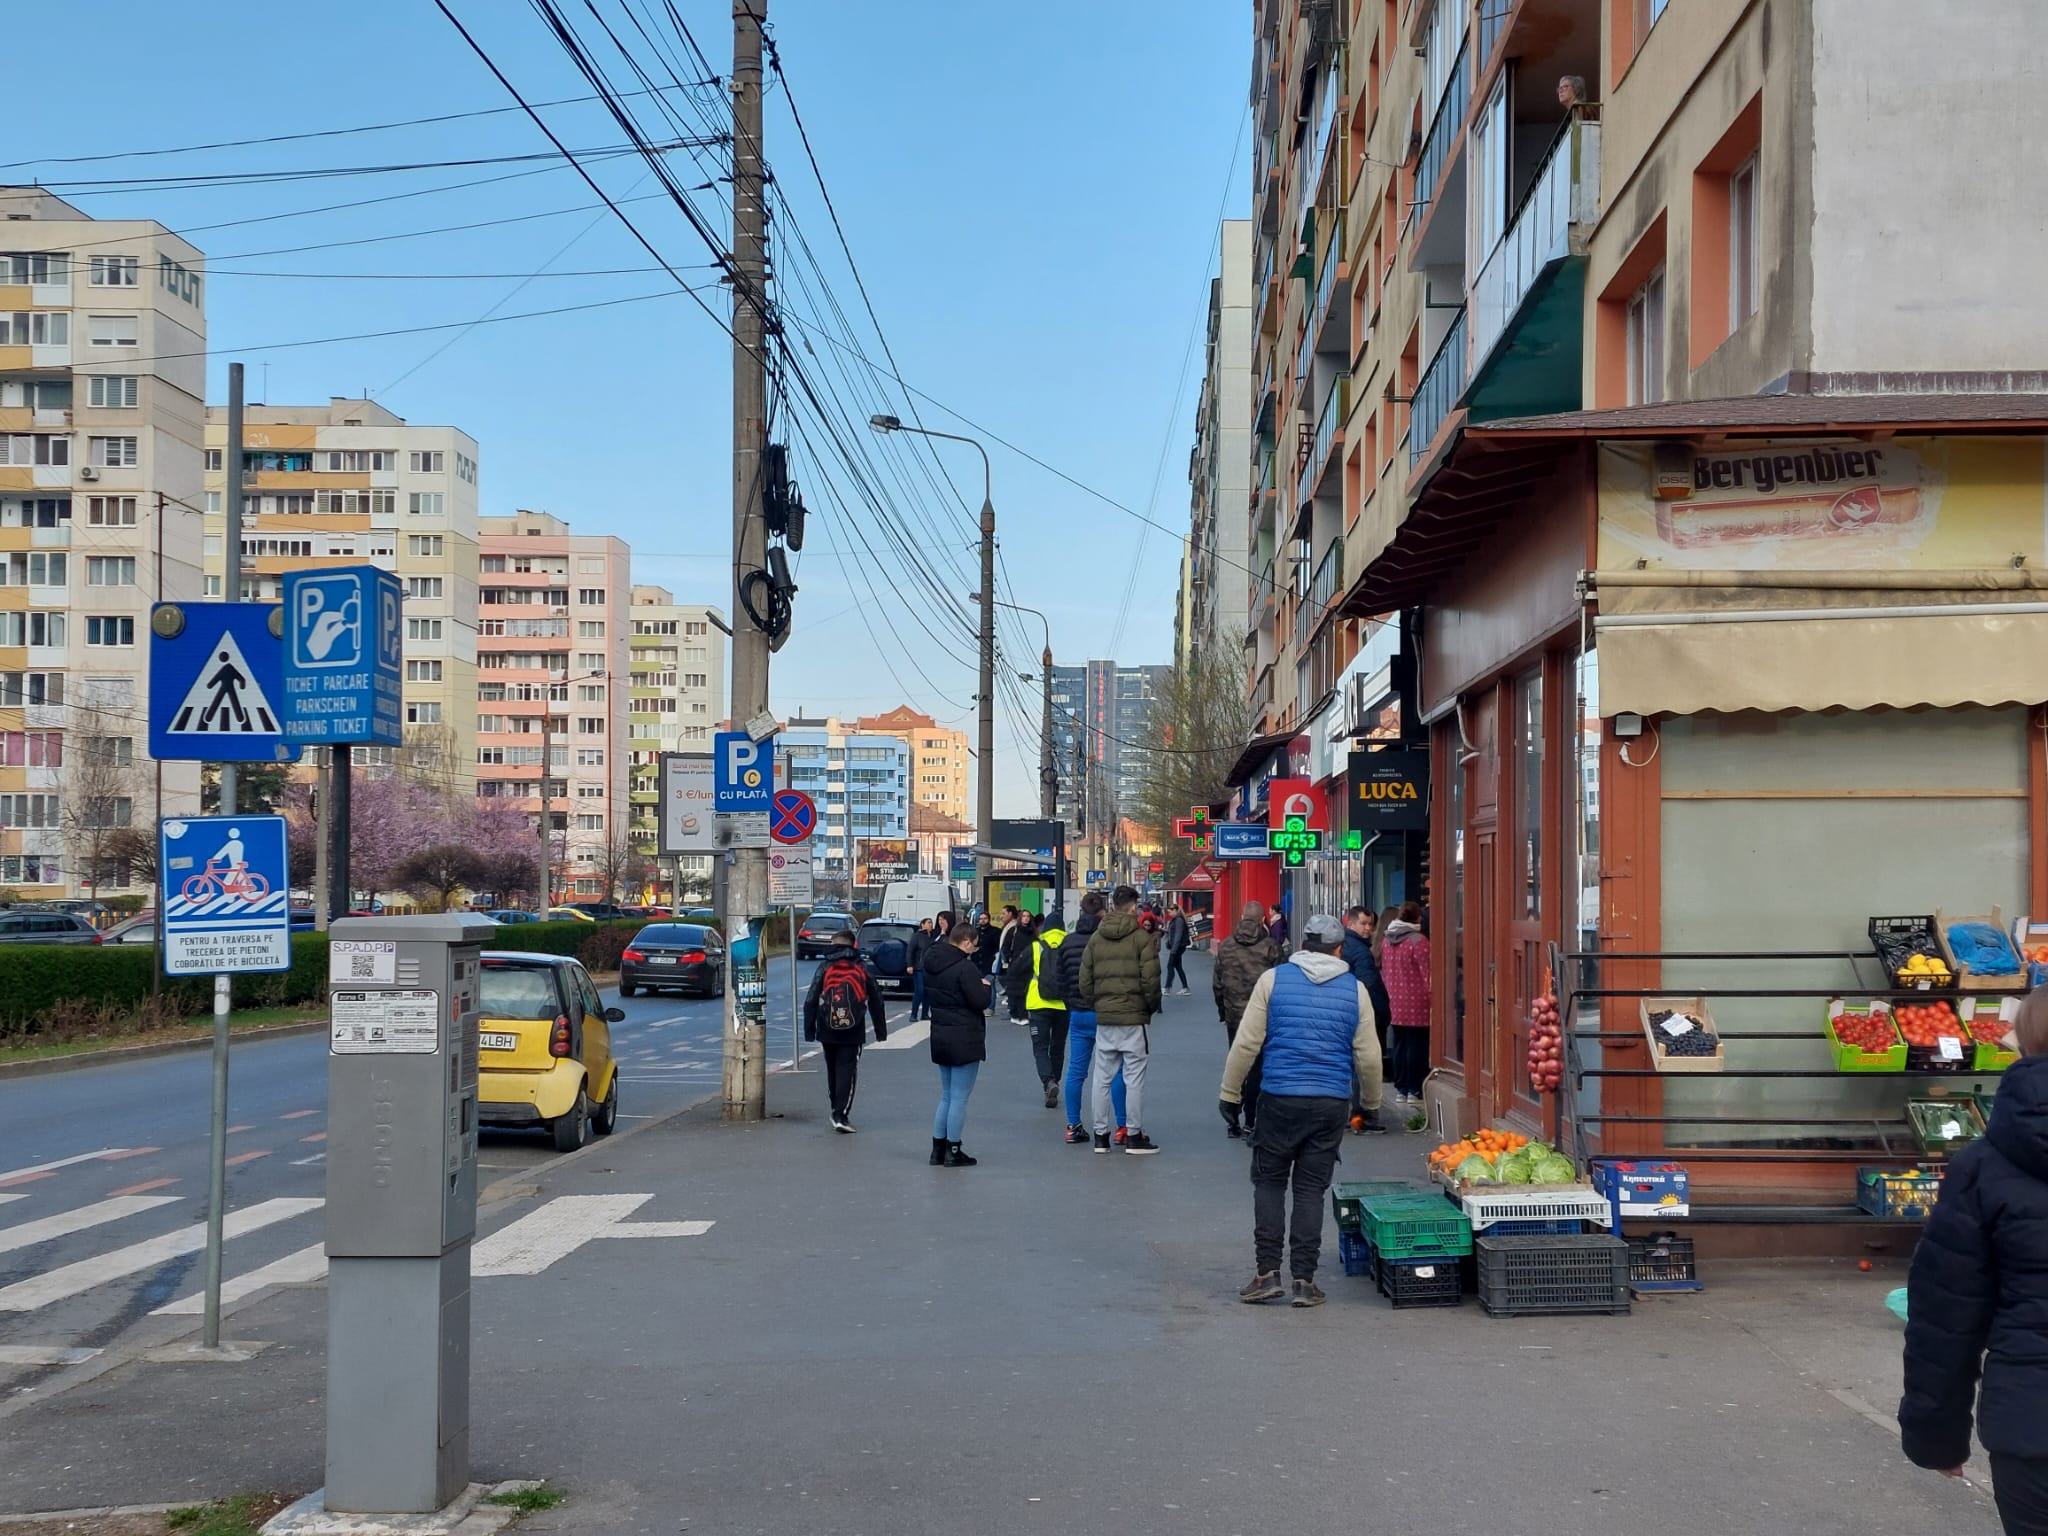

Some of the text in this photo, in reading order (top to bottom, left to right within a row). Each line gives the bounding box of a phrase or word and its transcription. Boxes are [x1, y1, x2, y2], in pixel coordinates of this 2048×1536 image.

[1694, 446, 1883, 494] Bergenbier
[301, 588, 325, 628] P
[286, 676, 318, 693] TICHET
[323, 673, 369, 691] PARCARE
[295, 696, 357, 714] PARKSCHEIN
[285, 719, 328, 737] PARKING
[332, 717, 368, 735] TICKET
[728, 740, 759, 785] P
[748, 771, 758, 784] C
[676, 790, 683, 799] 3
[720, 788, 768, 800] CU PLATĂ
[1360, 782, 1418, 799] LUCA
[1274, 833, 1317, 849] 07:53
[180, 934, 273, 946] PENTRU A TRAVERSA PE
[185, 945, 269, 957] TRECEREA DE PIETONI
[215, 958, 225, 967] DE
[228, 958, 238, 967] PE
[358, 993, 365, 1001] C
